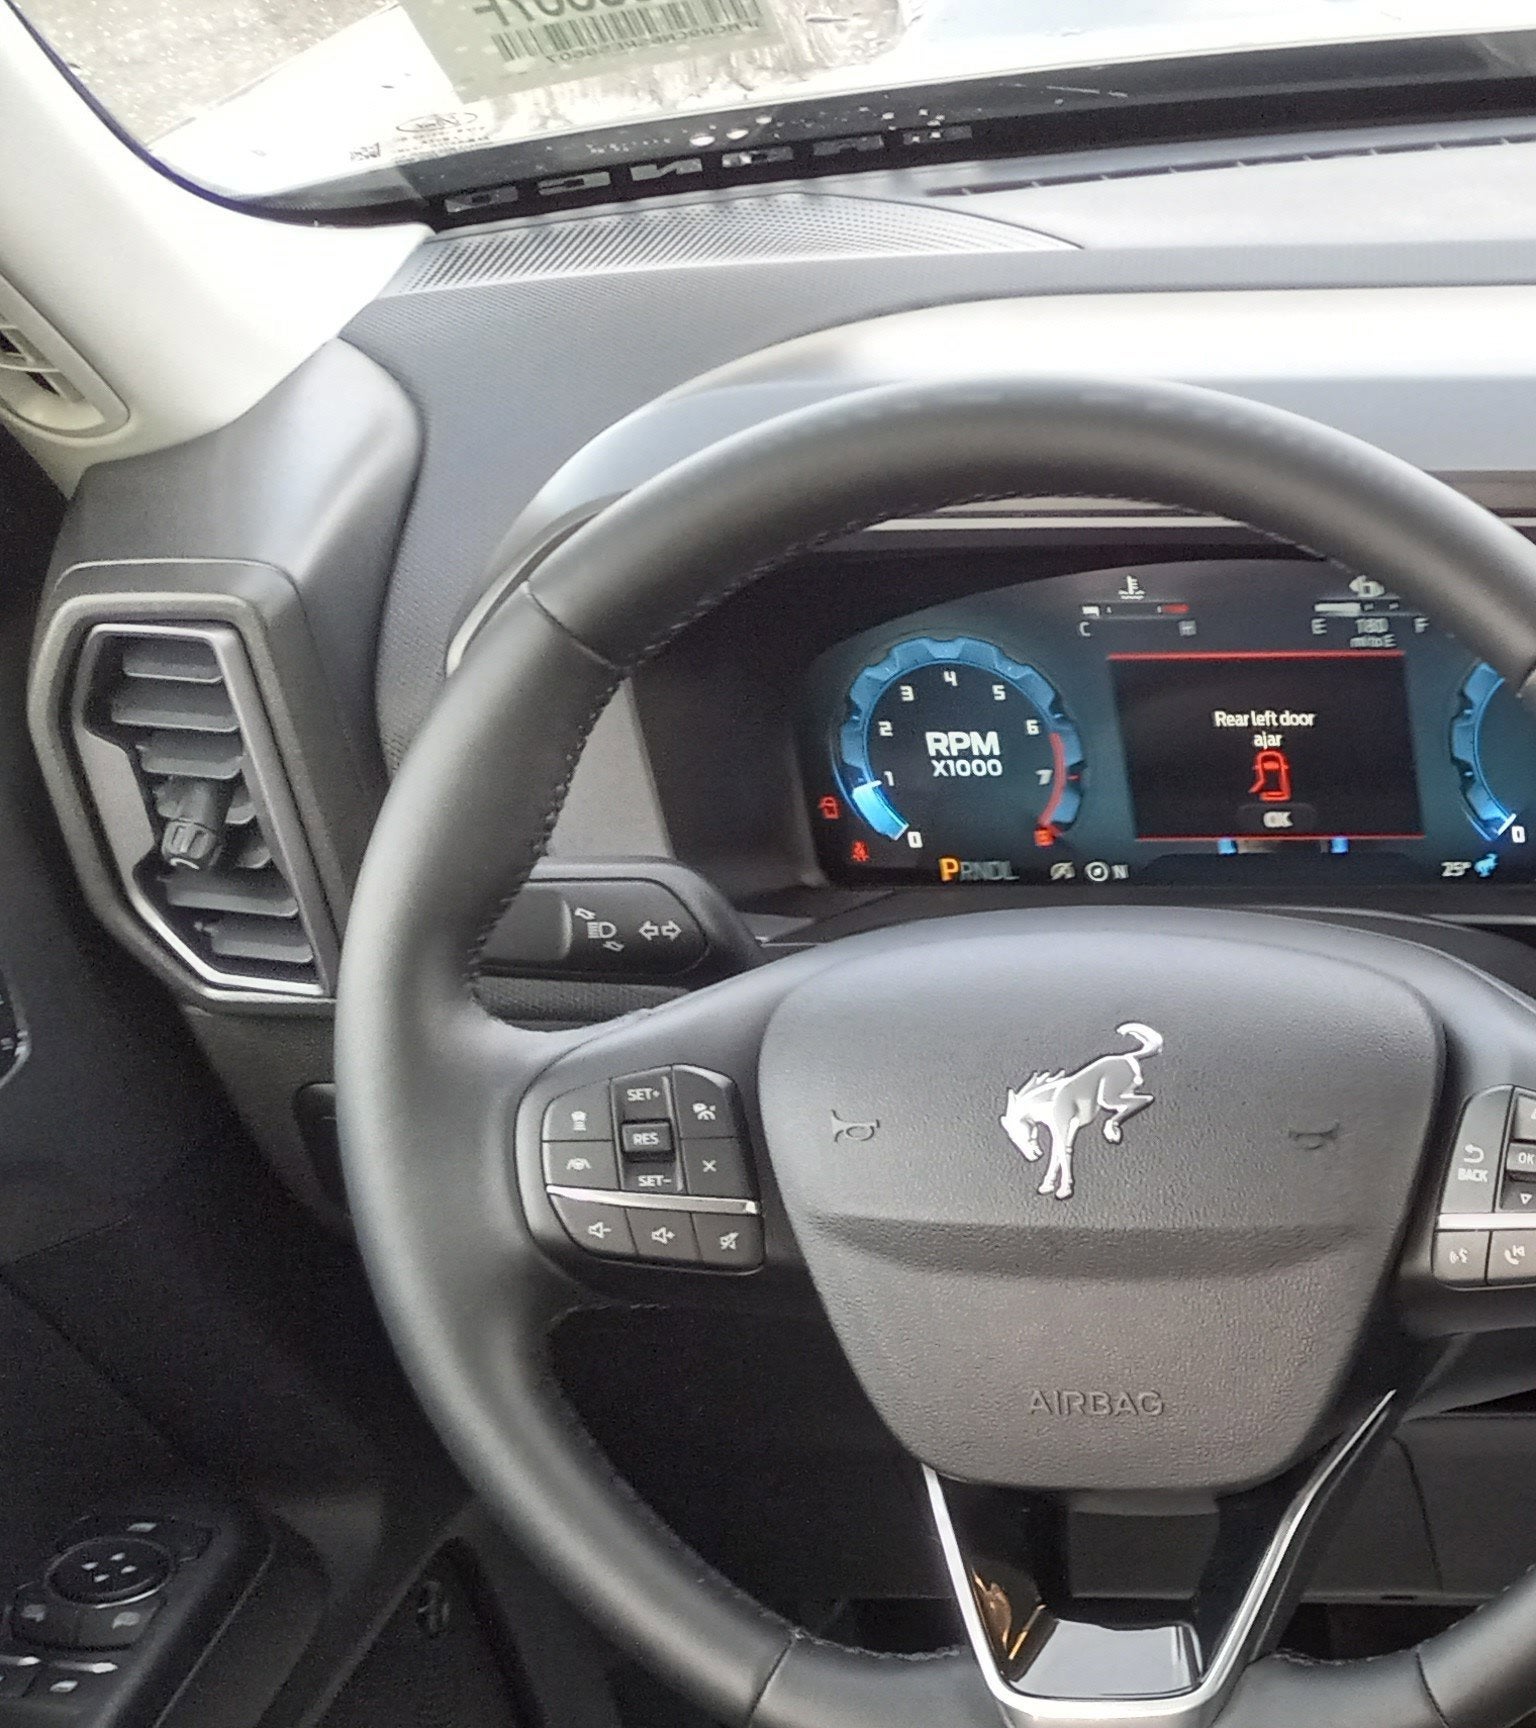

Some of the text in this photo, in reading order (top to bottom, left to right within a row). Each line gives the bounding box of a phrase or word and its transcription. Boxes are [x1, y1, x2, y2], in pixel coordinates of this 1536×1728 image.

[943, 671, 958, 686] 4
[900, 685, 915, 701] 3
[992, 684, 1006, 701] 5
[1026, 719, 1040, 735] 6
[1214, 710, 1316, 727] Rear left door
[878, 720, 893, 737] 2
[925, 731, 1001, 757] RPM
[1253, 731, 1283, 749] ajar
[931, 759, 1003, 777] X1000
[884, 770, 895, 786] 1
[907, 830, 923, 849] 0
[1511, 825, 1526, 844] 0
[632, 1132, 660, 1146] RES
[1518, 1152, 1535, 1165] OK
[1457, 1167, 1489, 1183] BACK
[1028, 1388, 1167, 1417] AIRBAG
